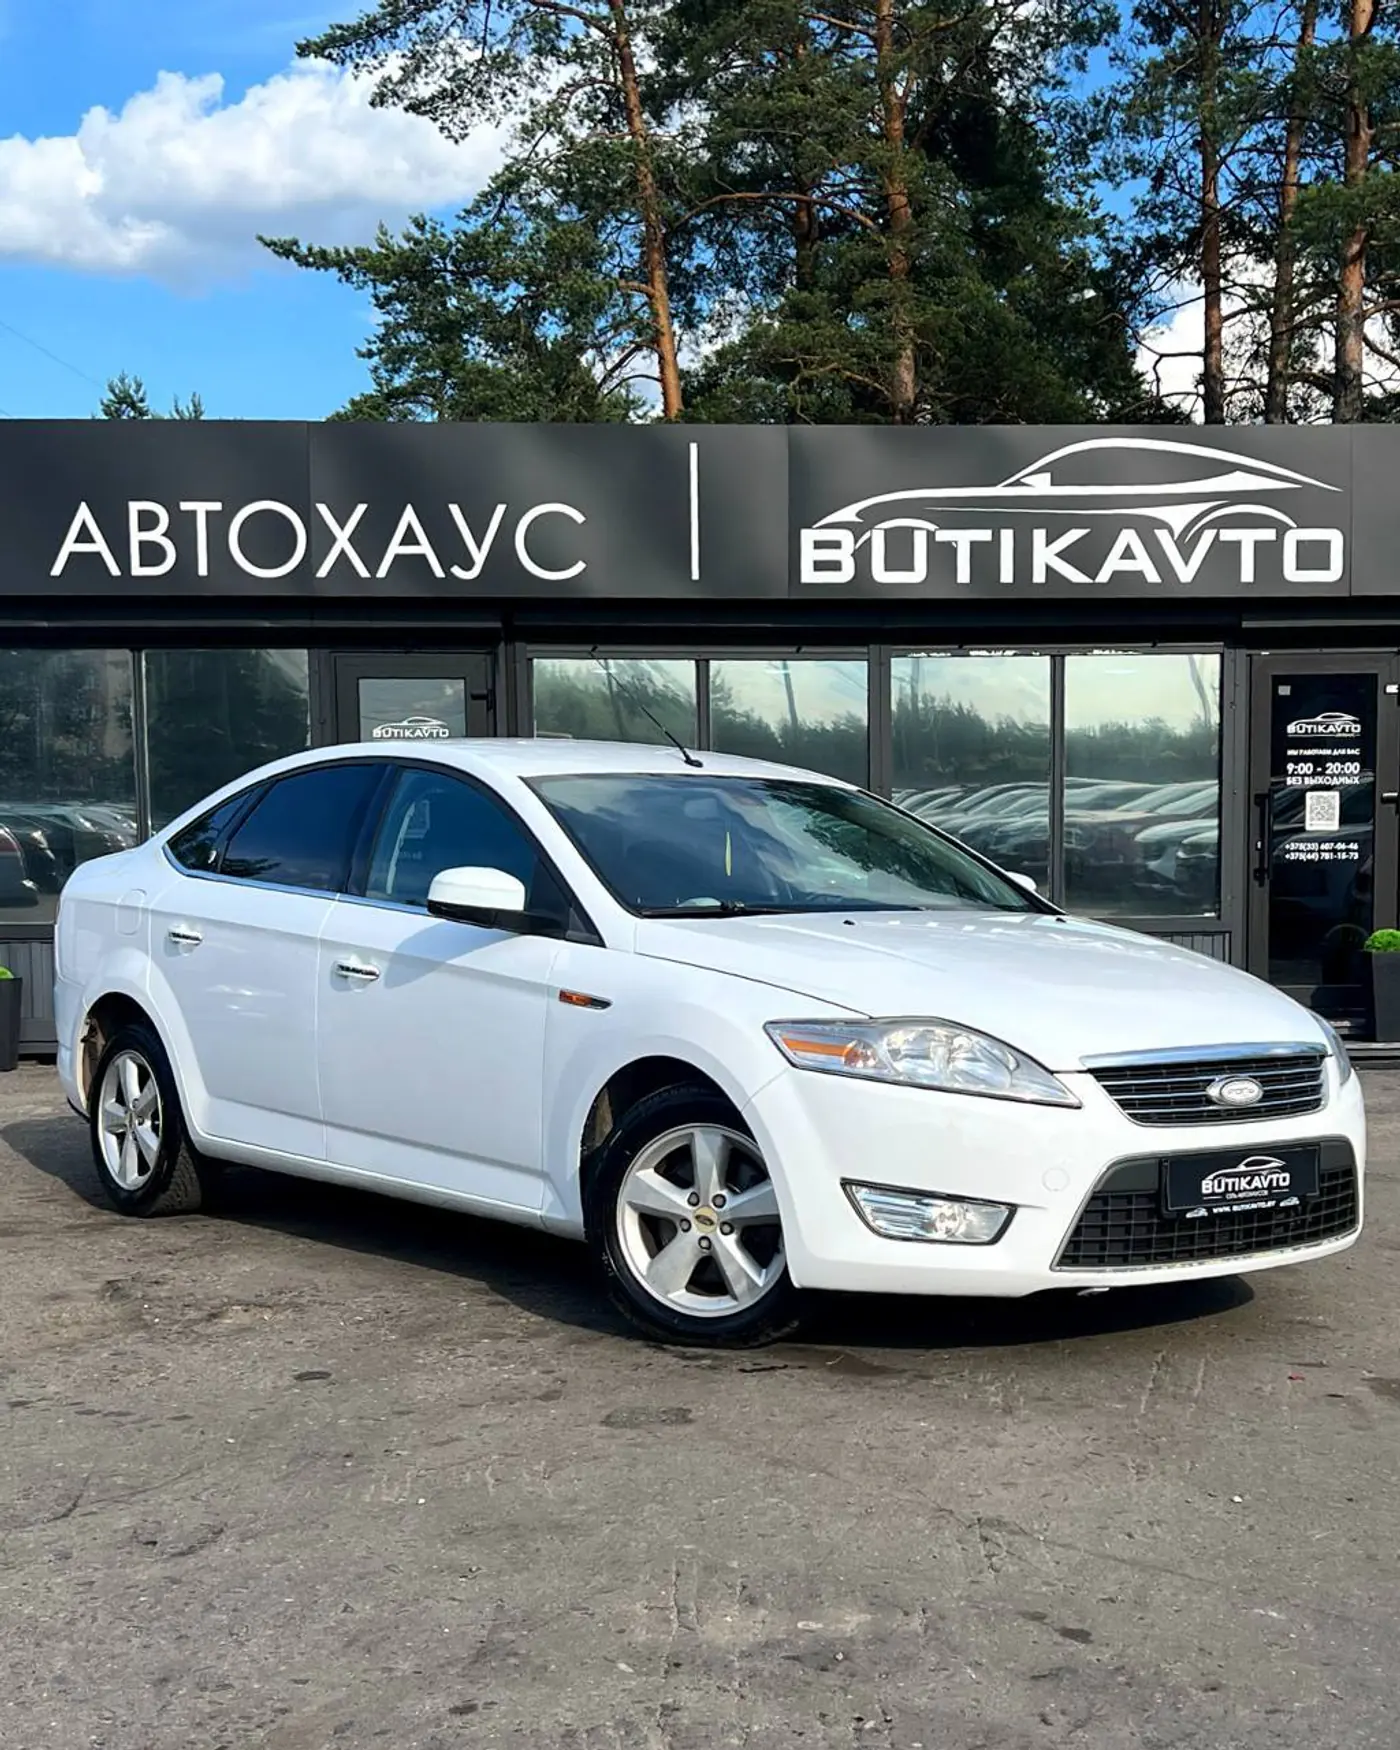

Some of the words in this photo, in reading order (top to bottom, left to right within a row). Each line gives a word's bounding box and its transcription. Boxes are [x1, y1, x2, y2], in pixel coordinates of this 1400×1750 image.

[50, 500, 587, 581] АВТОХАУС
[800, 528, 1344, 584] BUTIKAVTO
[372, 728, 449, 738] BUTIKAVTO
[1287, 724, 1361, 734] BUTIKAVTO
[1287, 762, 1313, 774] 9:00
[1325, 762, 1360, 774] 20:00
[1287, 777, 1302, 785] БЕЗ
[1304, 776, 1360, 785] ВЫХОДНЫХ
[1201, 1173, 1290, 1194] BUTIKAVTO
